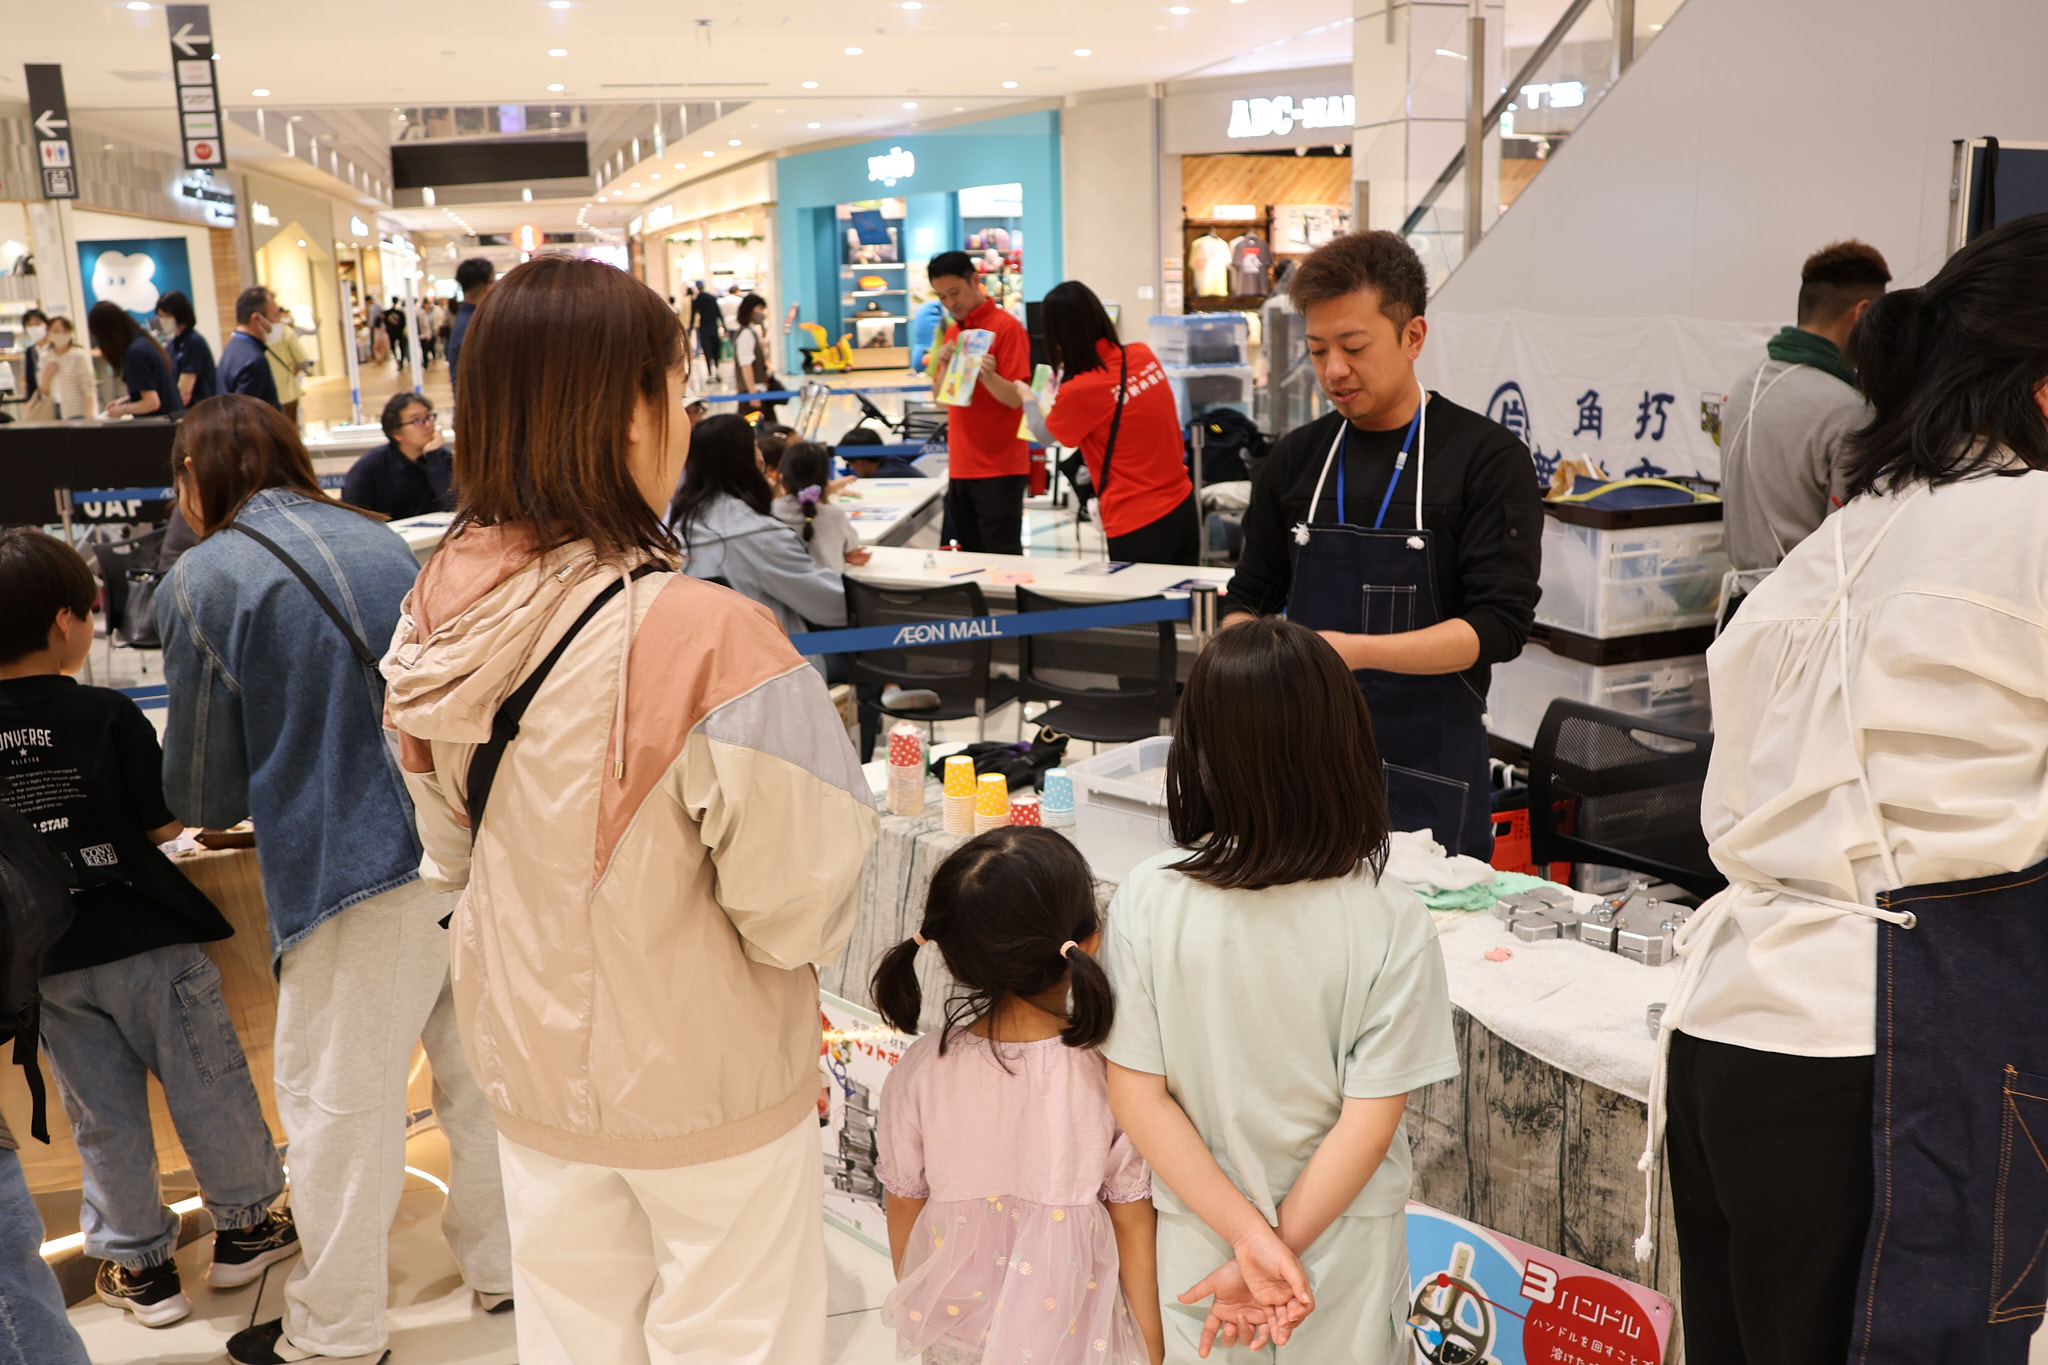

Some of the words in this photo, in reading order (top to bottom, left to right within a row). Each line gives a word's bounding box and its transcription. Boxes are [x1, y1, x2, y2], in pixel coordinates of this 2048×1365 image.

[1507, 81, 1584, 110] TS
[1573, 389, 1675, 441] 角打
[949, 618, 1003, 640] MALL
[33, 817, 69, 833] STAR
[1520, 1259, 1559, 1304] 3
[1557, 1290, 1641, 1339] ハンドル
